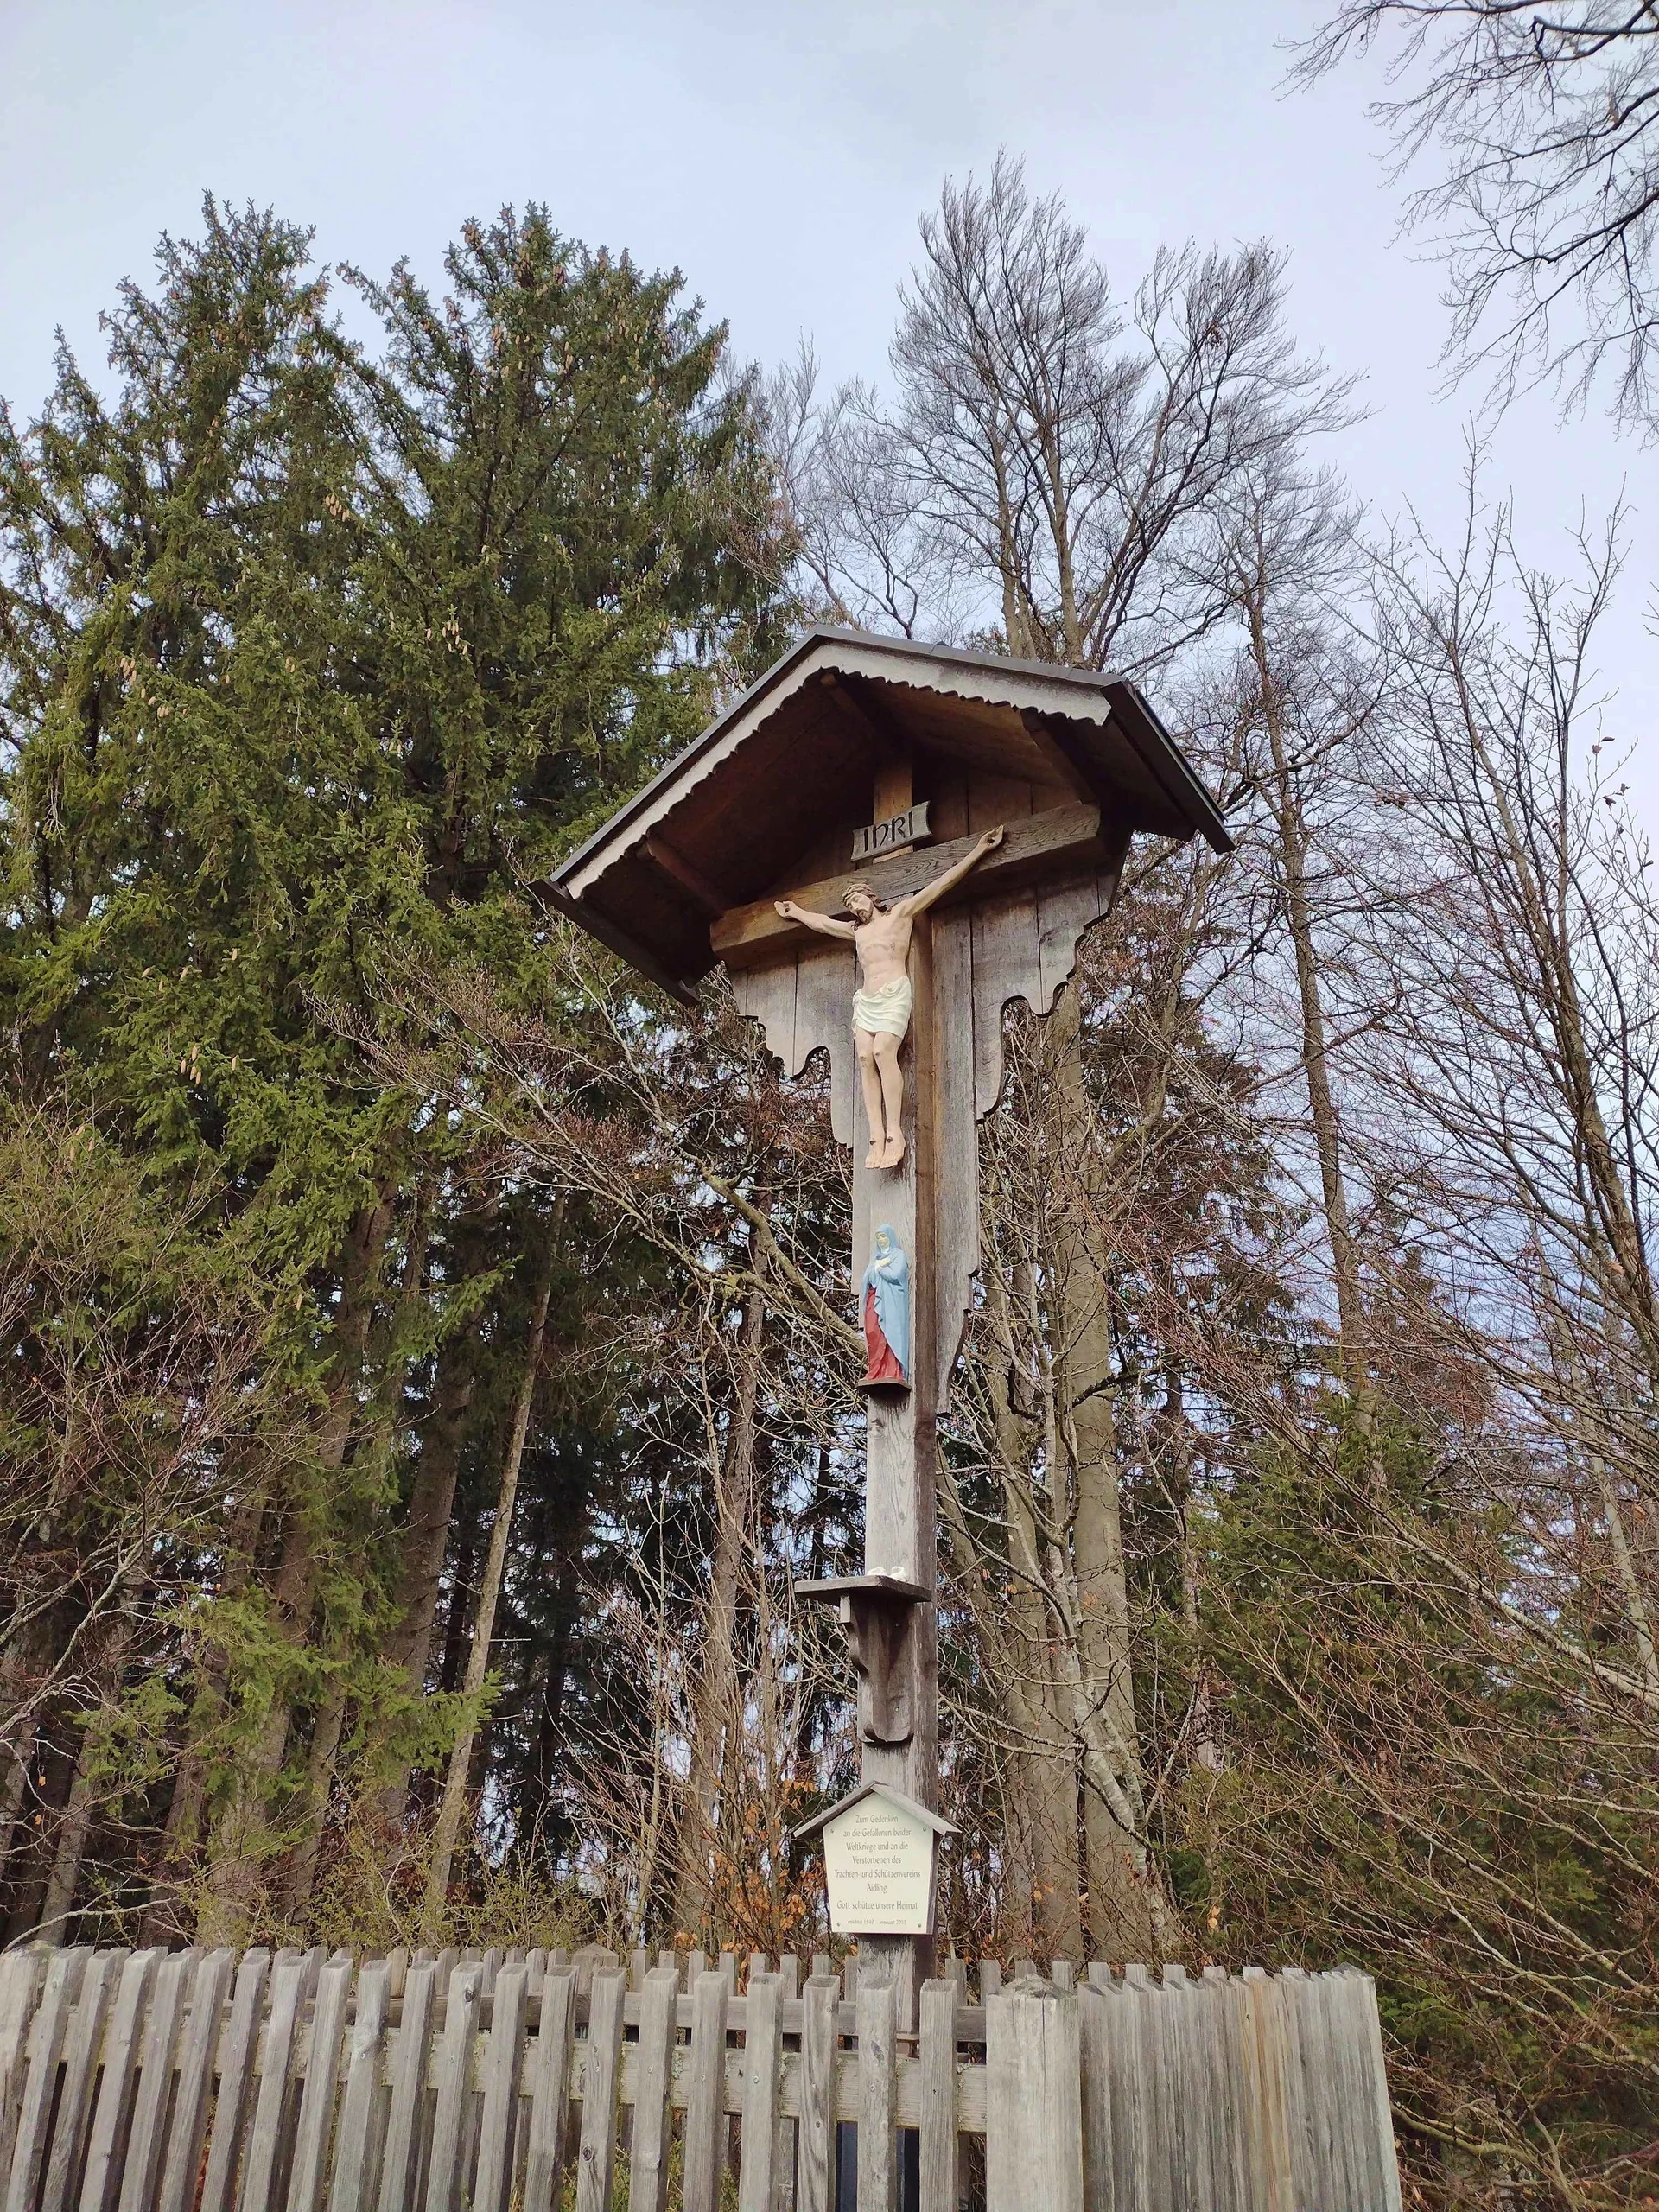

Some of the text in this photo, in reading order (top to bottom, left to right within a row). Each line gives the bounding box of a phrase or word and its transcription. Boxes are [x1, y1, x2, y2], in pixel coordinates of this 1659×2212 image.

[855, 1815, 899, 1823] Zum Gedenken
[852, 1828, 861, 1837] die
[861, 1828, 893, 1837] Gefallenen
[846, 1841, 876, 1853] Weltkriege
[878, 1841, 889, 1850] und
[899, 1841, 908, 1850] die
[852, 1855, 902, 1864] Verstorbenen des
[835, 1869, 921, 1878] Trachten- und Schützenvereins
[867, 1883, 887, 1894] Aidling
[836, 1900, 850, 1910] Gott
[896, 1900, 918, 1910] Heimat
